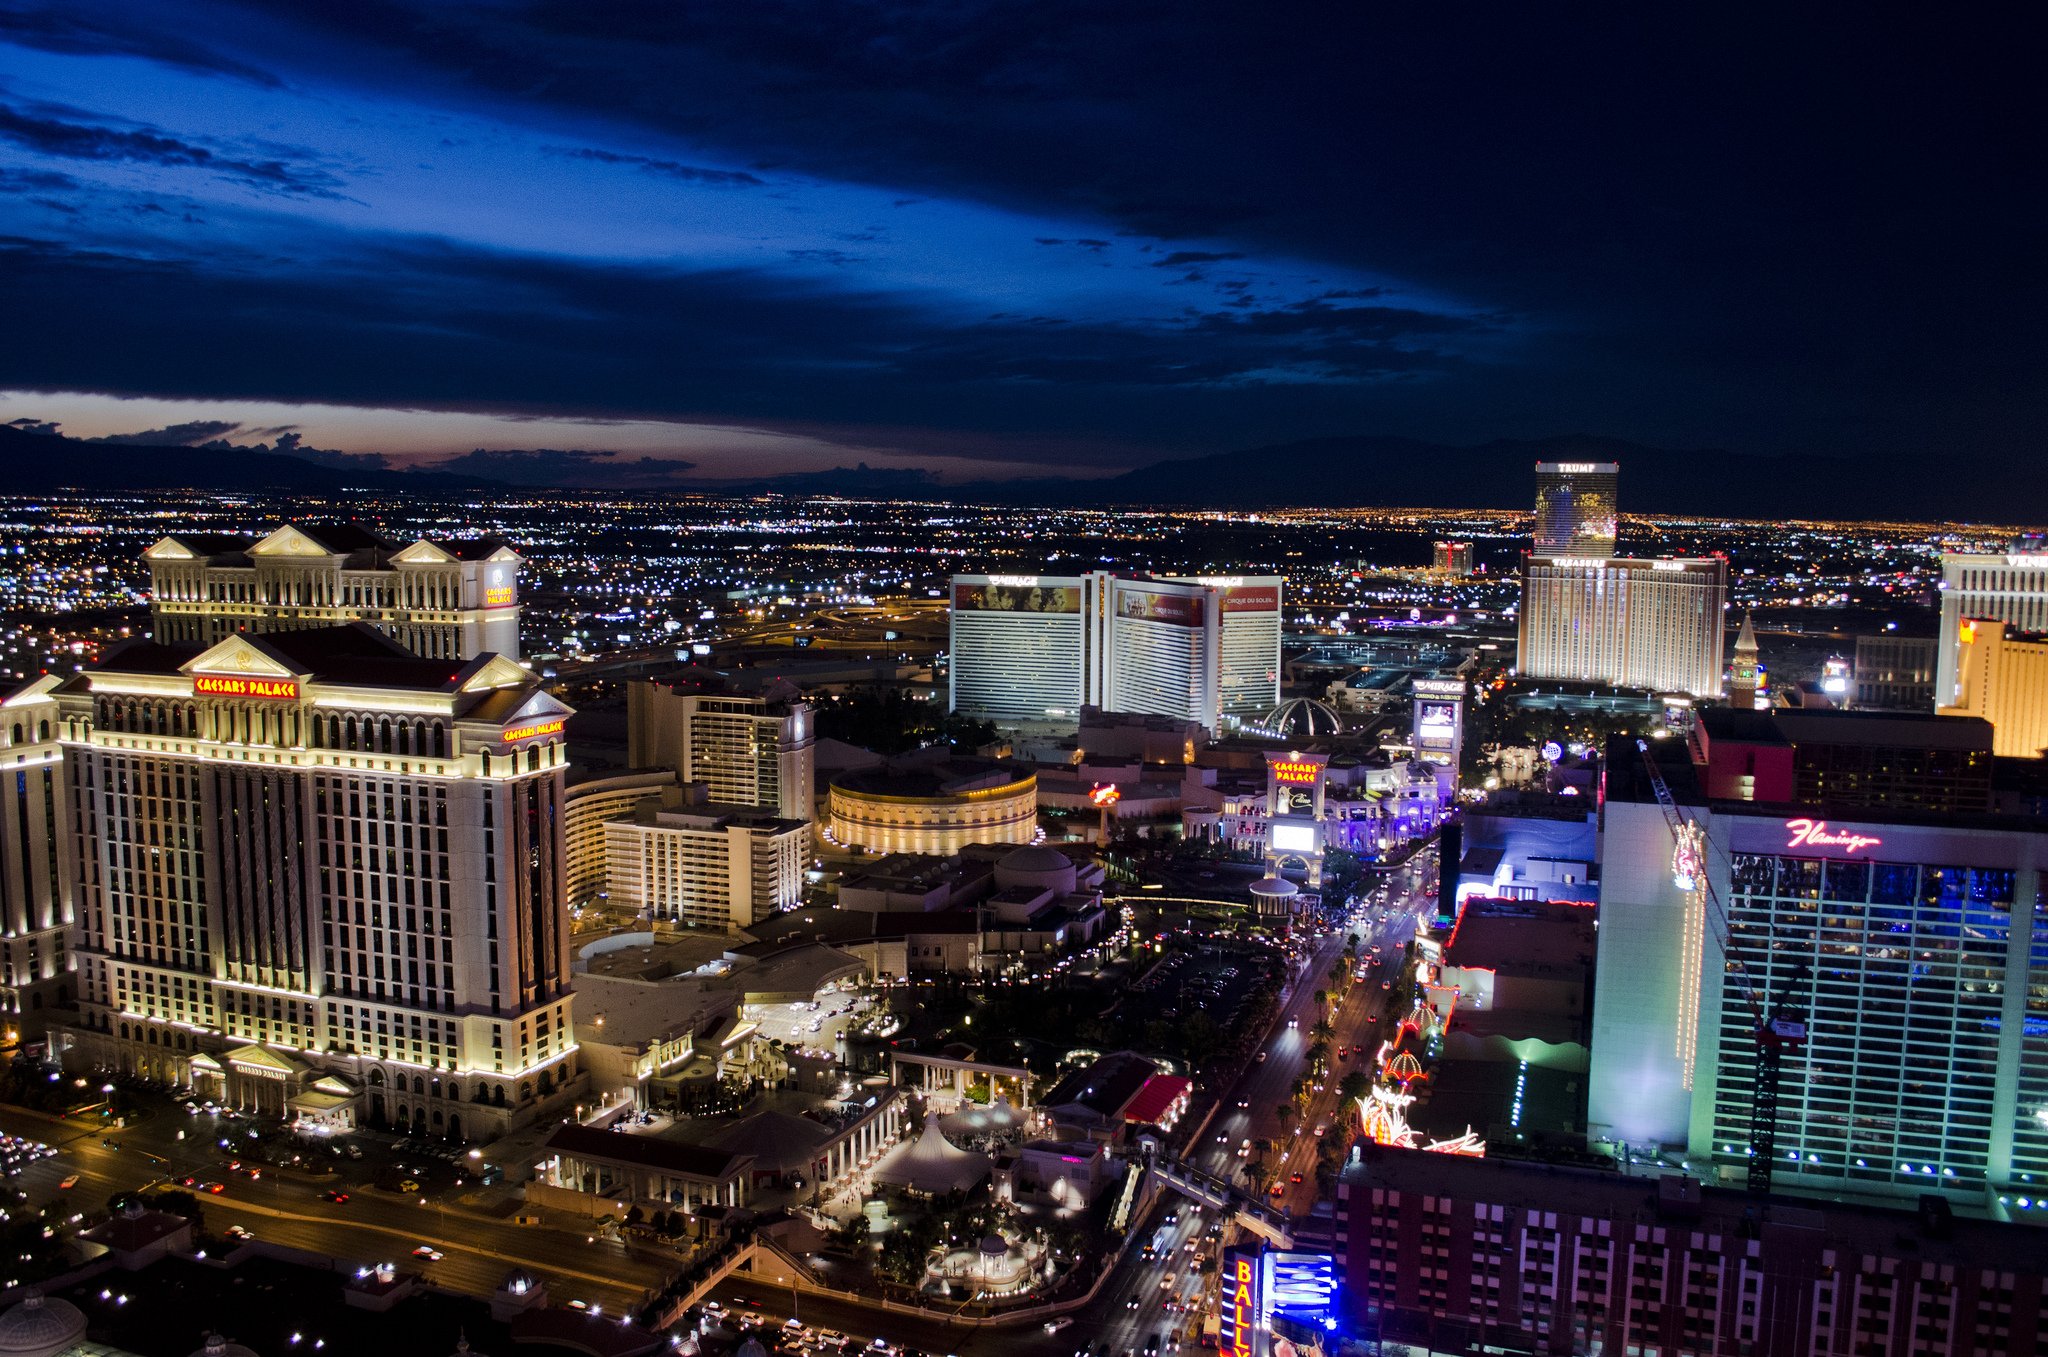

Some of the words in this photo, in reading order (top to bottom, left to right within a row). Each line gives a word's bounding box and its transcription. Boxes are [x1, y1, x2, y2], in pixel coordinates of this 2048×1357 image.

[1557, 463, 1595, 473] TRUMP
[1552, 559, 1606, 568] TREASURE
[998, 575, 1038, 587] MIRAGE
[486, 587, 513, 596] CAESARS
[487, 595, 511, 604] PALACE
[196, 678, 246, 694] CAESARS
[249, 681, 295, 697] PALACE
[1424, 682, 1463, 692] MIRAGE
[503, 726, 535, 742] CAESARS
[536, 721, 562, 735] PALACE
[1274, 762, 1317, 774] CAESARS
[1276, 773, 1315, 783] PALACE
[1786, 819, 1881, 853] Flamingo
